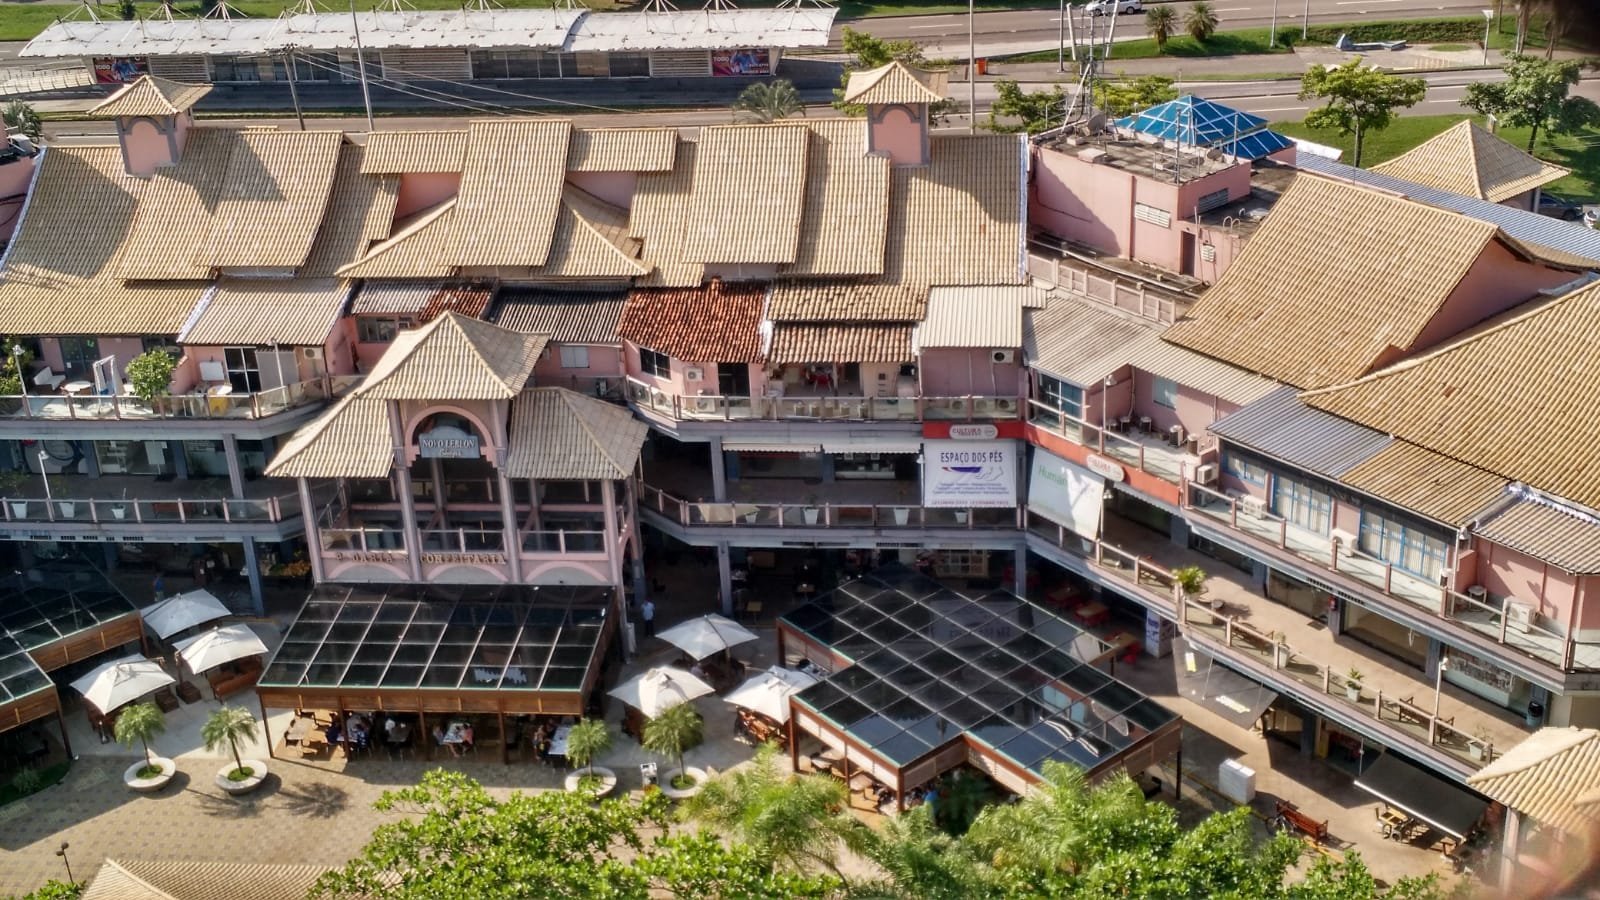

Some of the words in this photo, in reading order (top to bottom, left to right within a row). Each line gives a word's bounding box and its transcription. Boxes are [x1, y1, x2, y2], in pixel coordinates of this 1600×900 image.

[422, 439, 443, 448] NOVO
[445, 439, 475, 448] LEBLON
[940, 452, 969, 464] ESPAÇO
[972, 452, 987, 463] DOS
[989, 450, 1003, 463] PÉS
